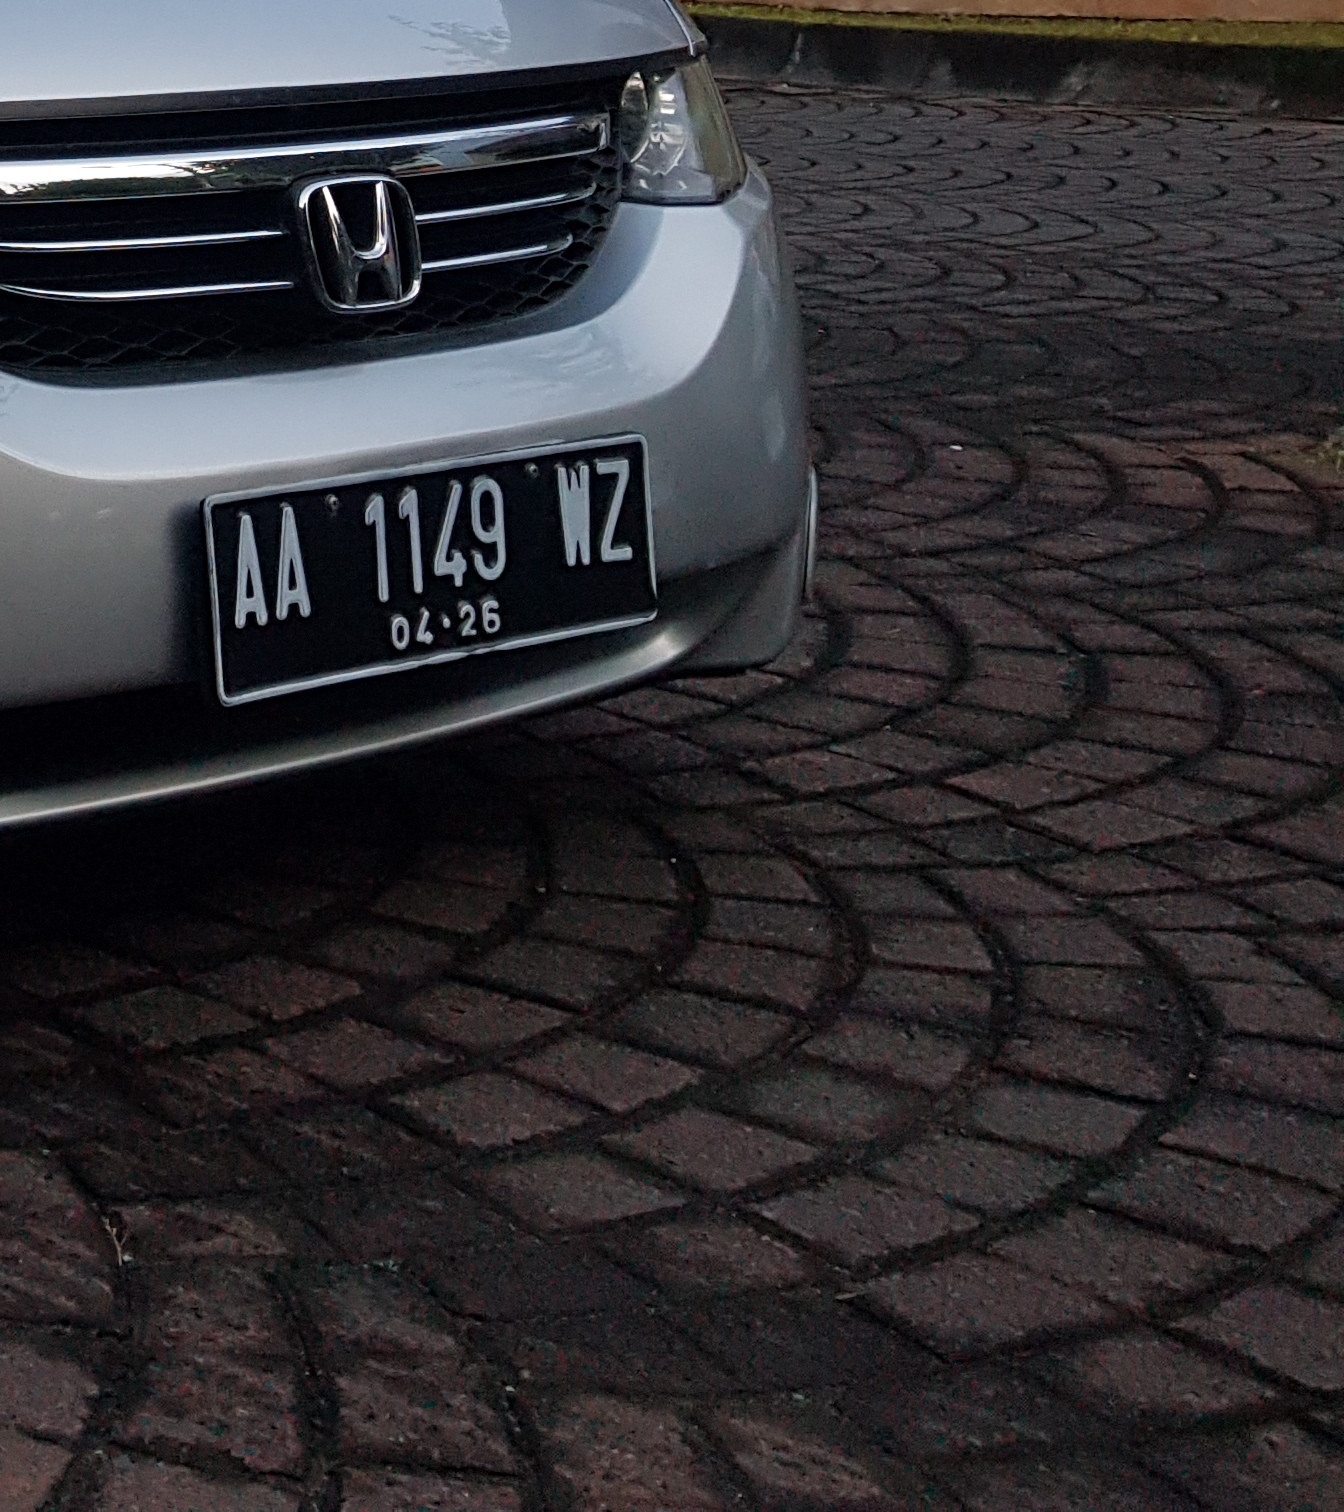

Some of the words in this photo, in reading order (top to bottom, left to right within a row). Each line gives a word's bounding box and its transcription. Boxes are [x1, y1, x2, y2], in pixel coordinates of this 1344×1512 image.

[235, 505, 310, 629] AA
[364, 477, 506, 603] 1149
[557, 458, 633, 567] WZ
